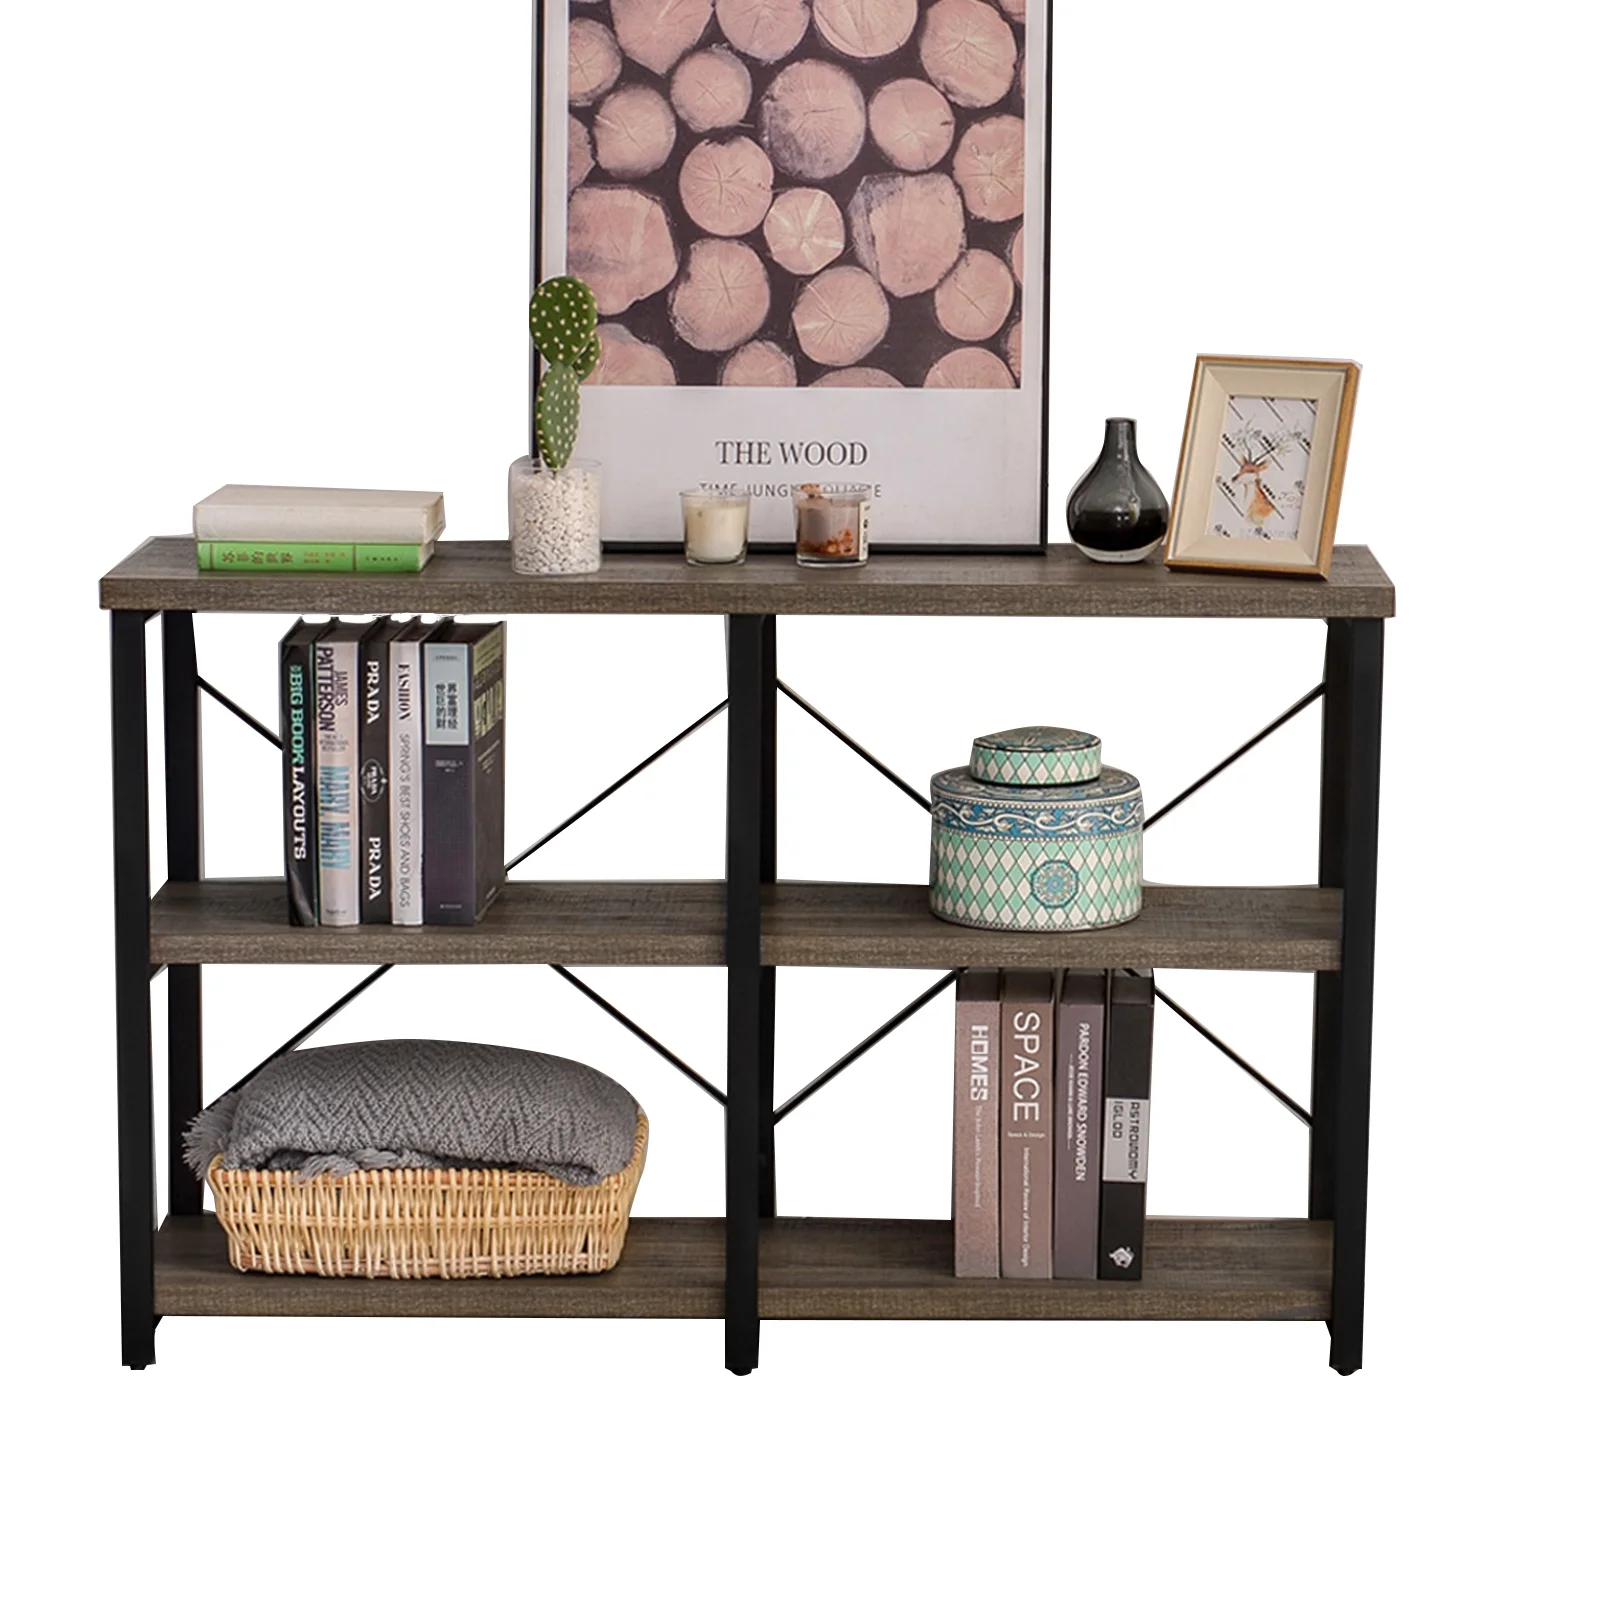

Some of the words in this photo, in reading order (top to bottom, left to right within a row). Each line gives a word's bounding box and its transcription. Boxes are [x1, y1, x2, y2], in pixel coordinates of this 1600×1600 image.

[715, 441, 771, 465] THE
[779, 441, 868, 466] WOOD
[289, 673, 304, 706] BIG
[317, 646, 335, 732] PATTERSON
[335, 671, 349, 707] JAMES
[367, 661, 380, 725] PRADA
[398, 663, 411, 721] FASHION
[291, 708, 305, 765] BOOK
[399, 733, 412, 783] SPRING'S
[292, 766, 306, 860] LAYOUTS
[319, 765, 350, 816] MARY,
[399, 785, 411, 809] BEST
[320, 822, 351, 869] MARY
[400, 811, 411, 847] SHOES
[369, 837, 382, 900] PRADA
[400, 848, 411, 876] AND
[399, 878, 411, 908] BAGS
[971, 1025, 988, 1100] HOMES
[1013, 1011, 1041, 1121] SPACE
[1077, 1022, 1090, 1071] PARDON
[1076, 1072, 1089, 1121] EDWARD
[1075, 1123, 1088, 1182] SNOWDEN
[1128, 1101, 1140, 1180] ASTRONOMY
[1022, 1146, 1030, 1187] International
[1021, 1243, 1030, 1267] Design
[1022, 1220, 1030, 1243] Interior
